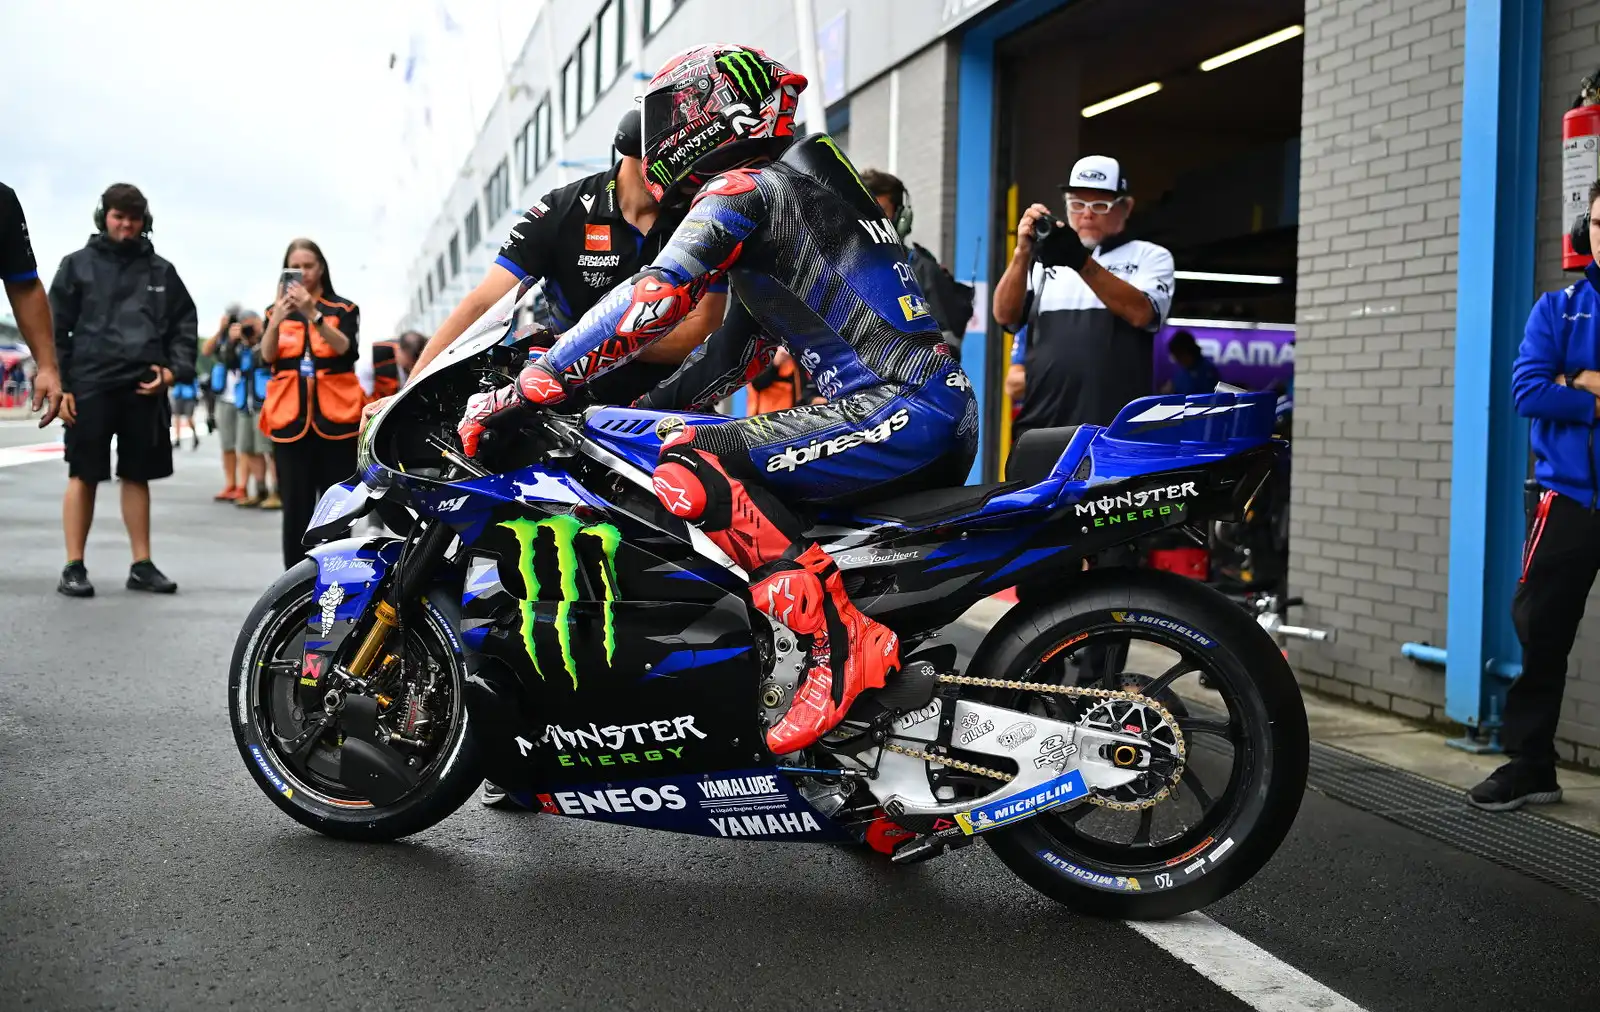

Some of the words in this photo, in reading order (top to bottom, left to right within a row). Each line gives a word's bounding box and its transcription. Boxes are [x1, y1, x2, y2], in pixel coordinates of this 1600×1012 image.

[668, 121, 726, 165] MONSTER
[1197, 338, 1295, 366] RAMA
[766, 408, 910, 473] alpinestars
[1074, 481, 1200, 517] MONSTER
[1093, 502, 1186, 528] ENERGY
[431, 608, 460, 649] MICHELIN
[1138, 614, 1210, 647] MICHELIN
[960, 720, 995, 745] GILLES
[252, 747, 282, 786] MICHELIN
[1034, 743, 1079, 769] RCB
[554, 784, 687, 815] ENEOS
[697, 775, 780, 799] YAMALUBE
[994, 781, 1073, 820] MICHELIN
[708, 812, 822, 836] YAMAHA
[1043, 851, 1113, 887] MICHELIN
